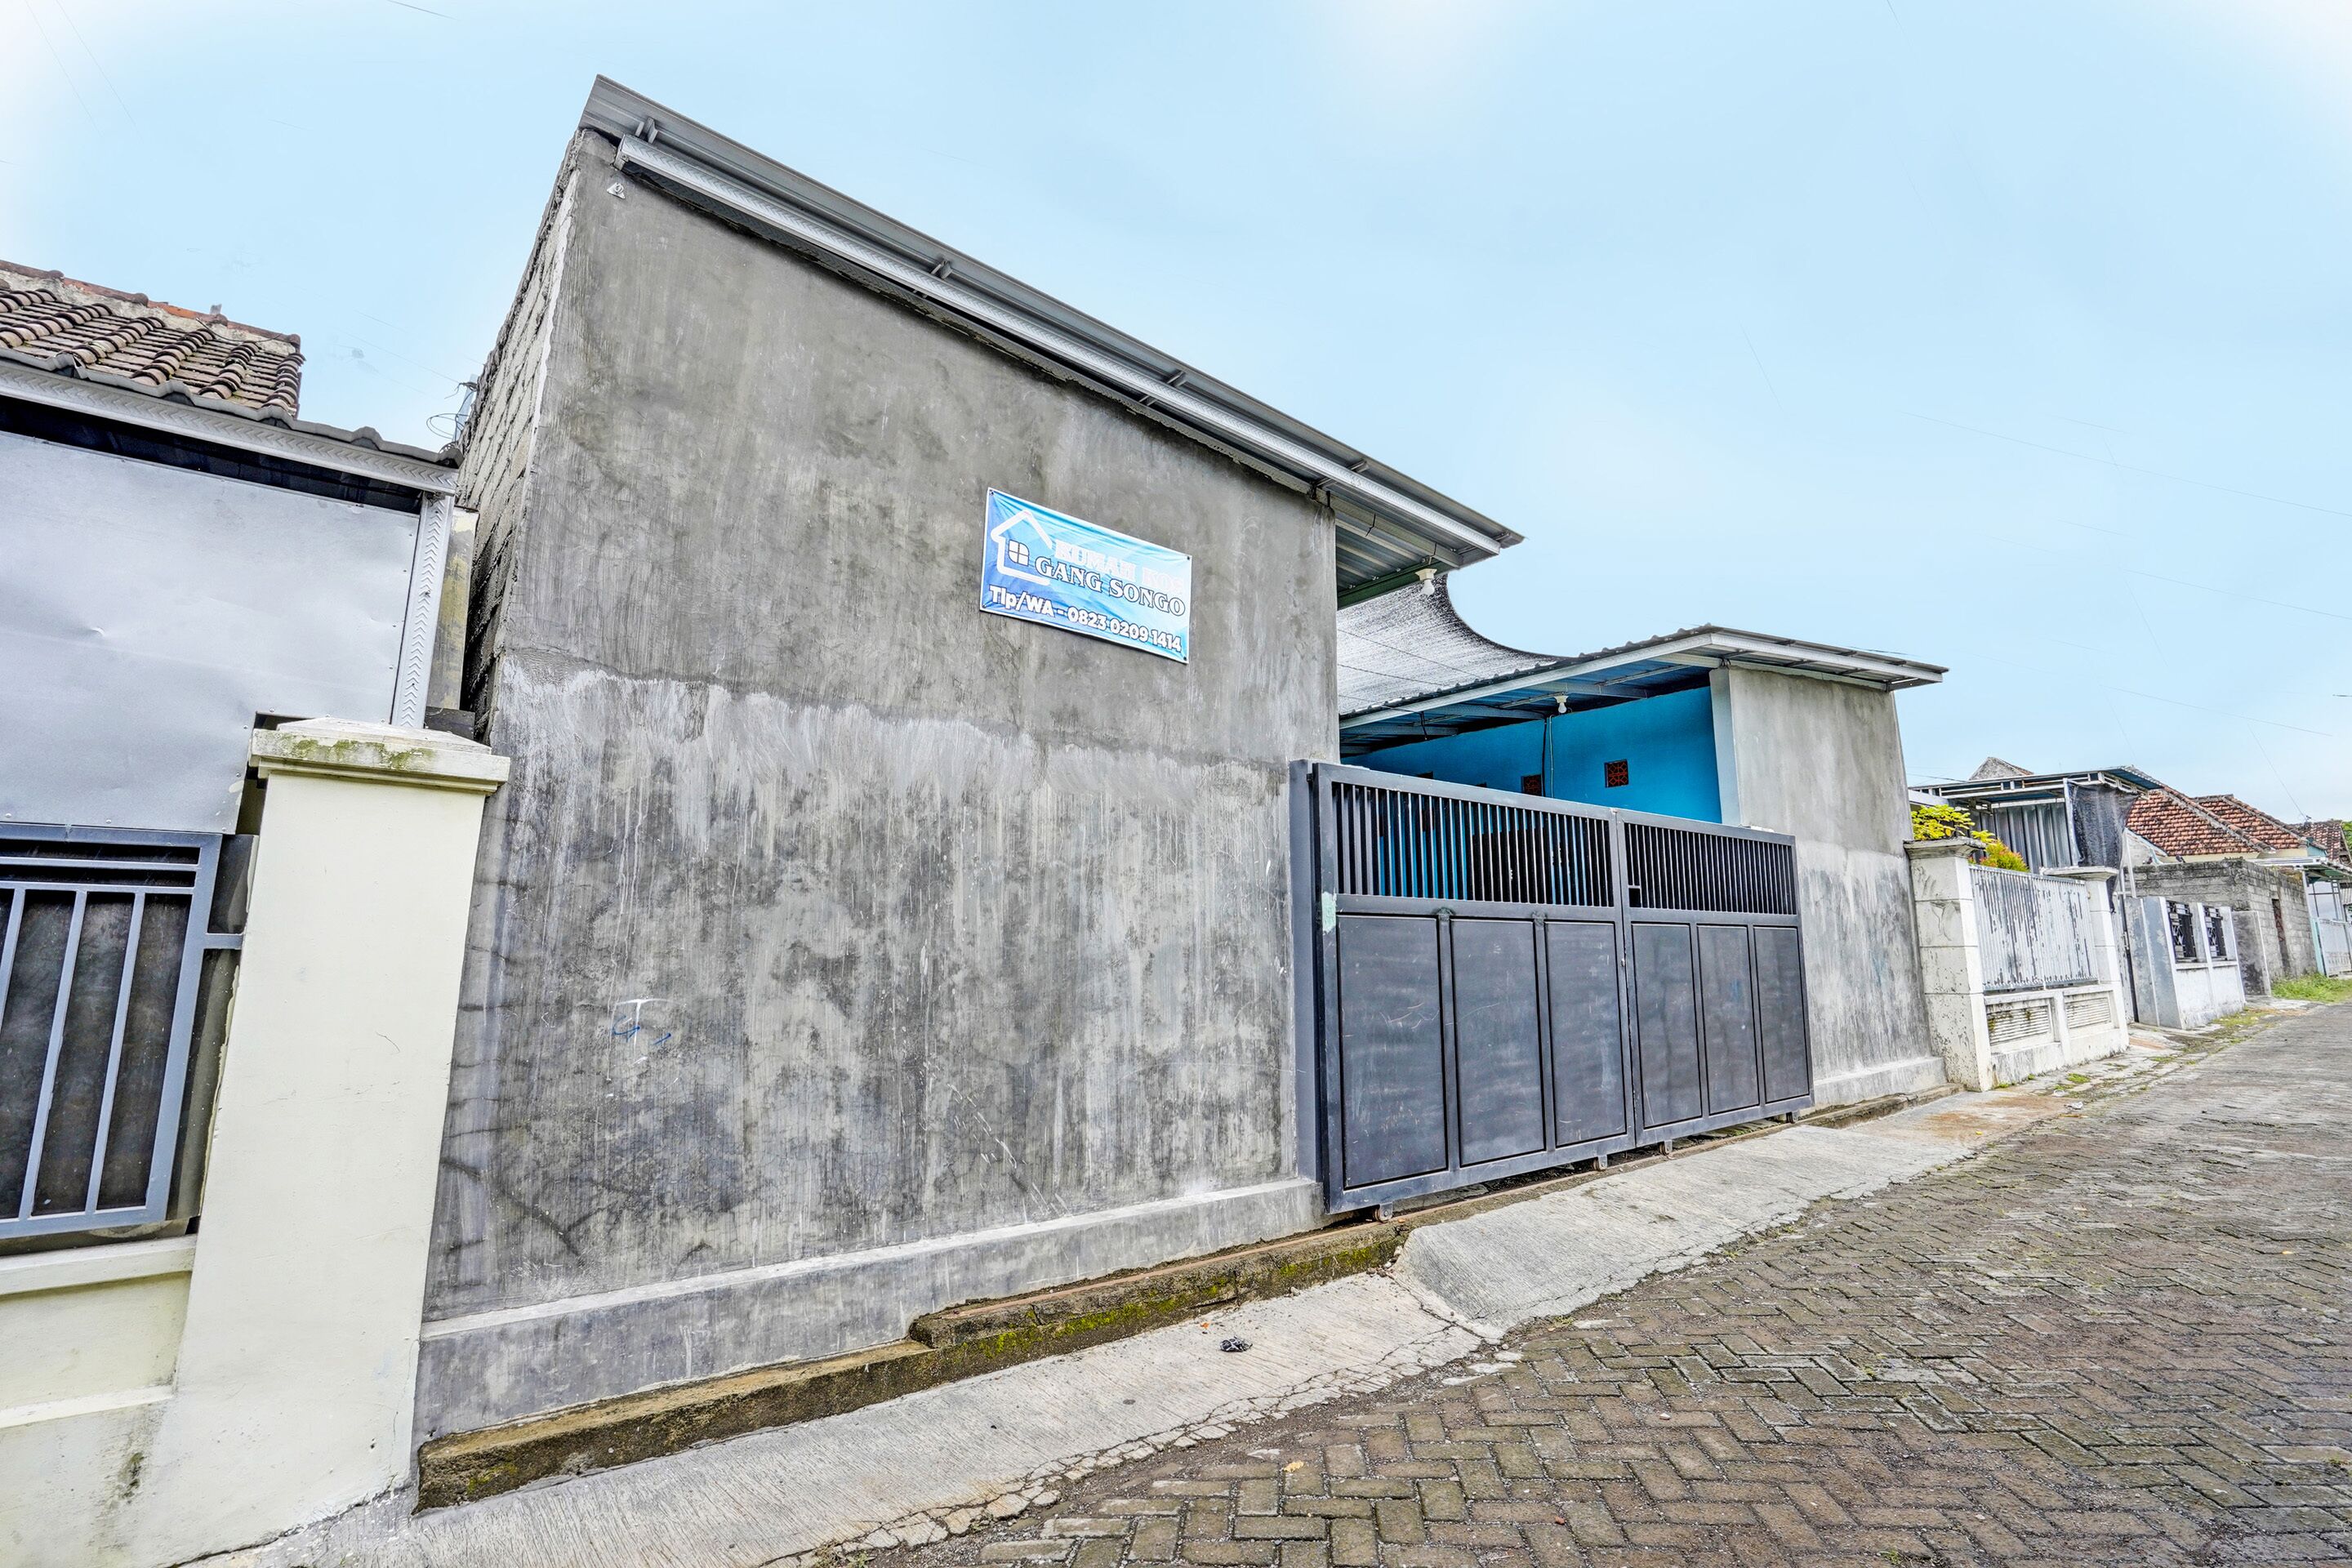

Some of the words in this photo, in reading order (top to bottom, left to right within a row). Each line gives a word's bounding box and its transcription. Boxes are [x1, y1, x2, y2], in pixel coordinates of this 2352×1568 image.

[1035, 556, 1102, 592] GANG
[1109, 578, 1185, 617] SONGO
[1067, 606, 1107, 630] 0823
[1110, 618, 1149, 643] 0209
[1151, 630, 1182, 653] 1414
